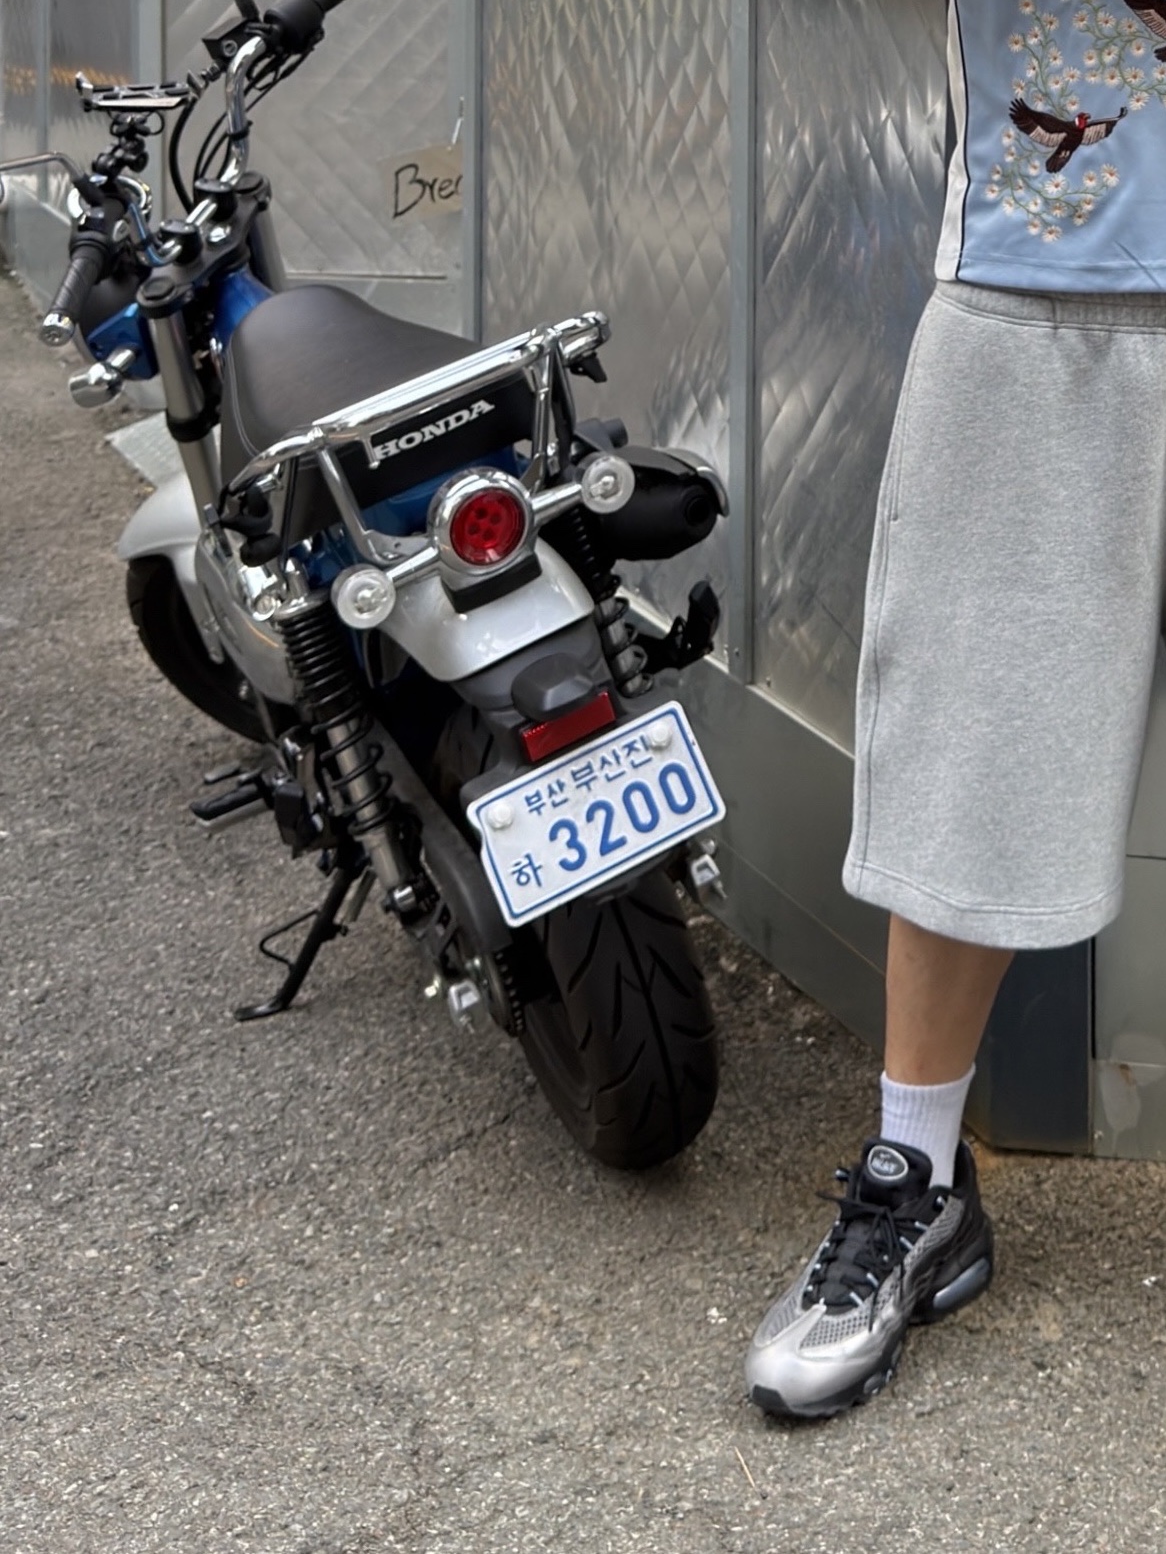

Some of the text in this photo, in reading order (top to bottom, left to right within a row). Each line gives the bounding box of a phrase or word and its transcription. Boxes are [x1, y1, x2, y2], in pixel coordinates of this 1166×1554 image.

[373, 400, 496, 460] HONDA
[524, 734, 654, 816] 부산 부산진
[511, 761, 696, 888] 하 3200
